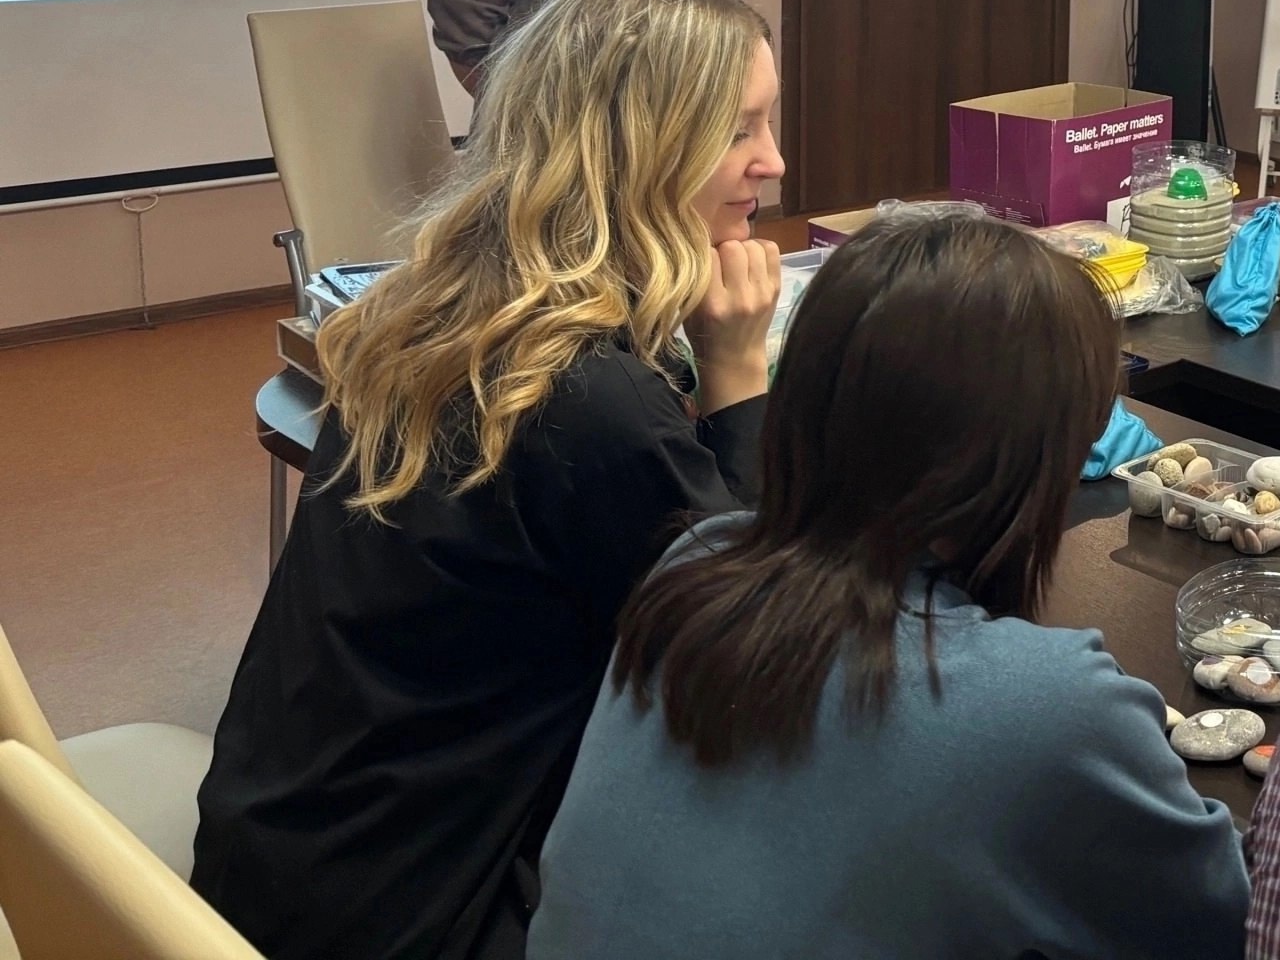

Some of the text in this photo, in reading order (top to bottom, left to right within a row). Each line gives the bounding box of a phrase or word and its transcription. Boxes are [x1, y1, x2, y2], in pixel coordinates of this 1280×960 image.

[1066, 114, 1164, 143] Ballet. Paper matters
